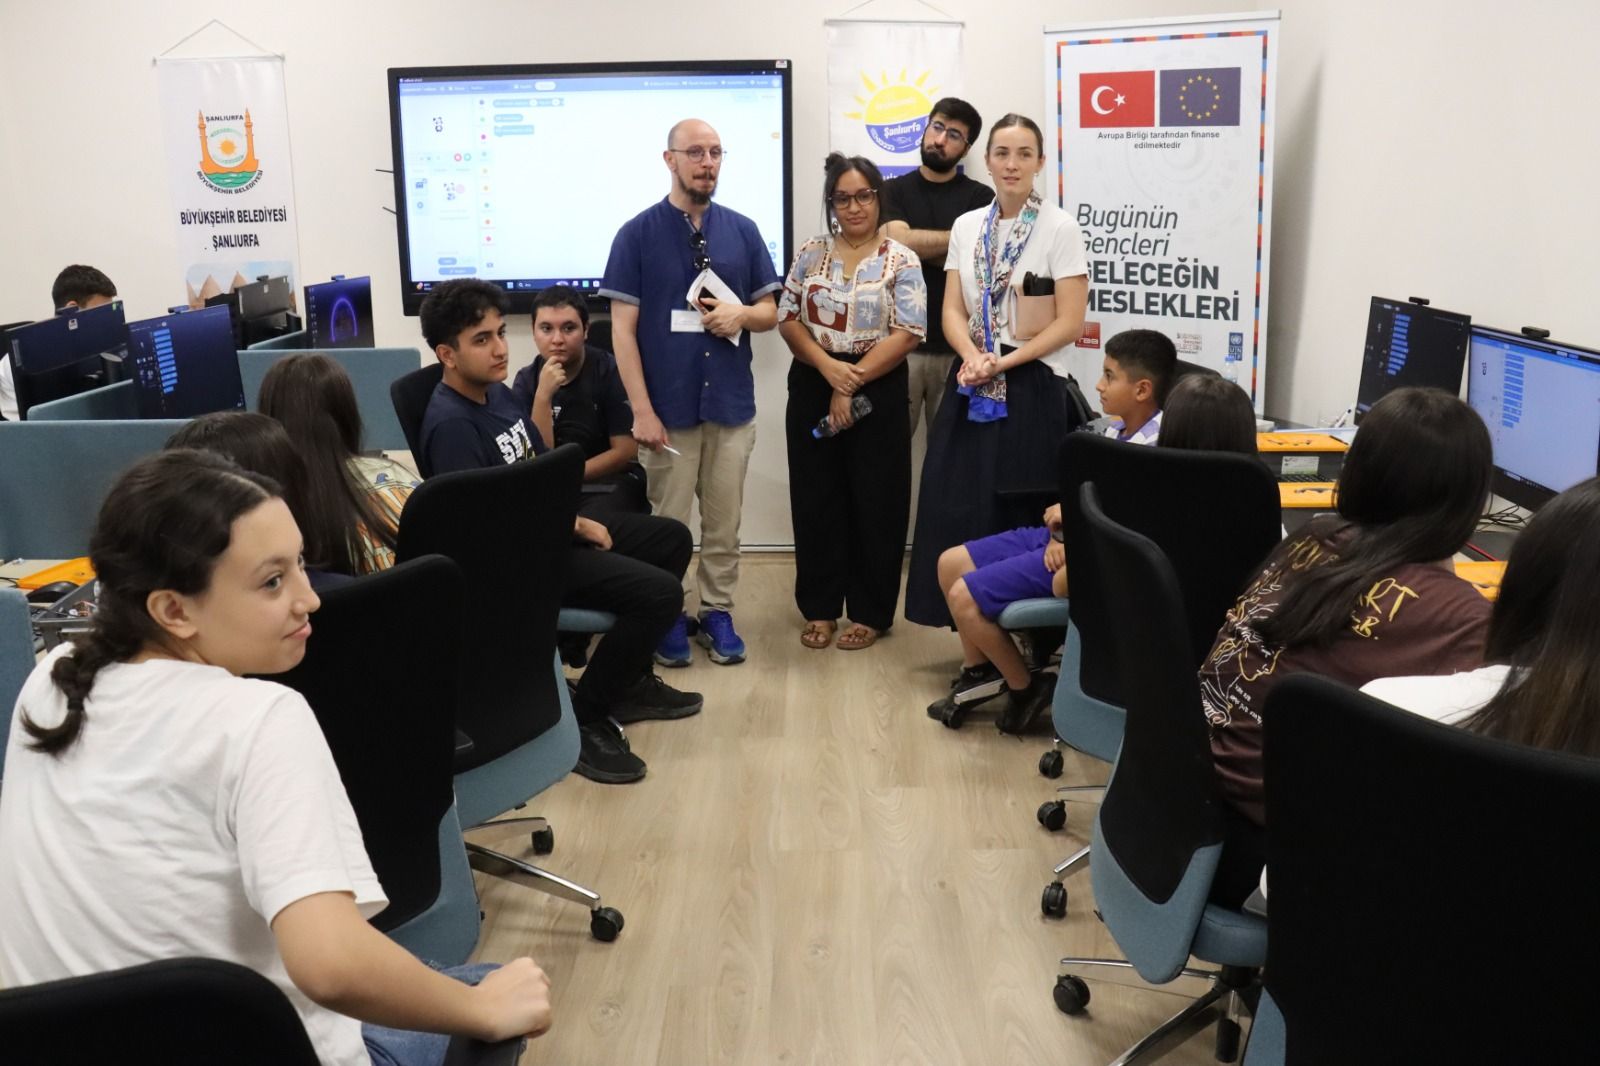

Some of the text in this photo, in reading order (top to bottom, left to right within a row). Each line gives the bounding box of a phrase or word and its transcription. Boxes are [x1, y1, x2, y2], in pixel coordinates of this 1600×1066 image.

[205, 114, 244, 123] ŞANLIURFA
[1098, 130, 1220, 140] Avrupa Birliği tarafından finanse
[1134, 141, 1181, 149] edilmektedir
[180, 205, 287, 227] BÜYÜKŞEHİR BELEDİYESİ
[1077, 203, 1179, 234] Bugünün
[212, 233, 260, 251] ŞANLIURFA
